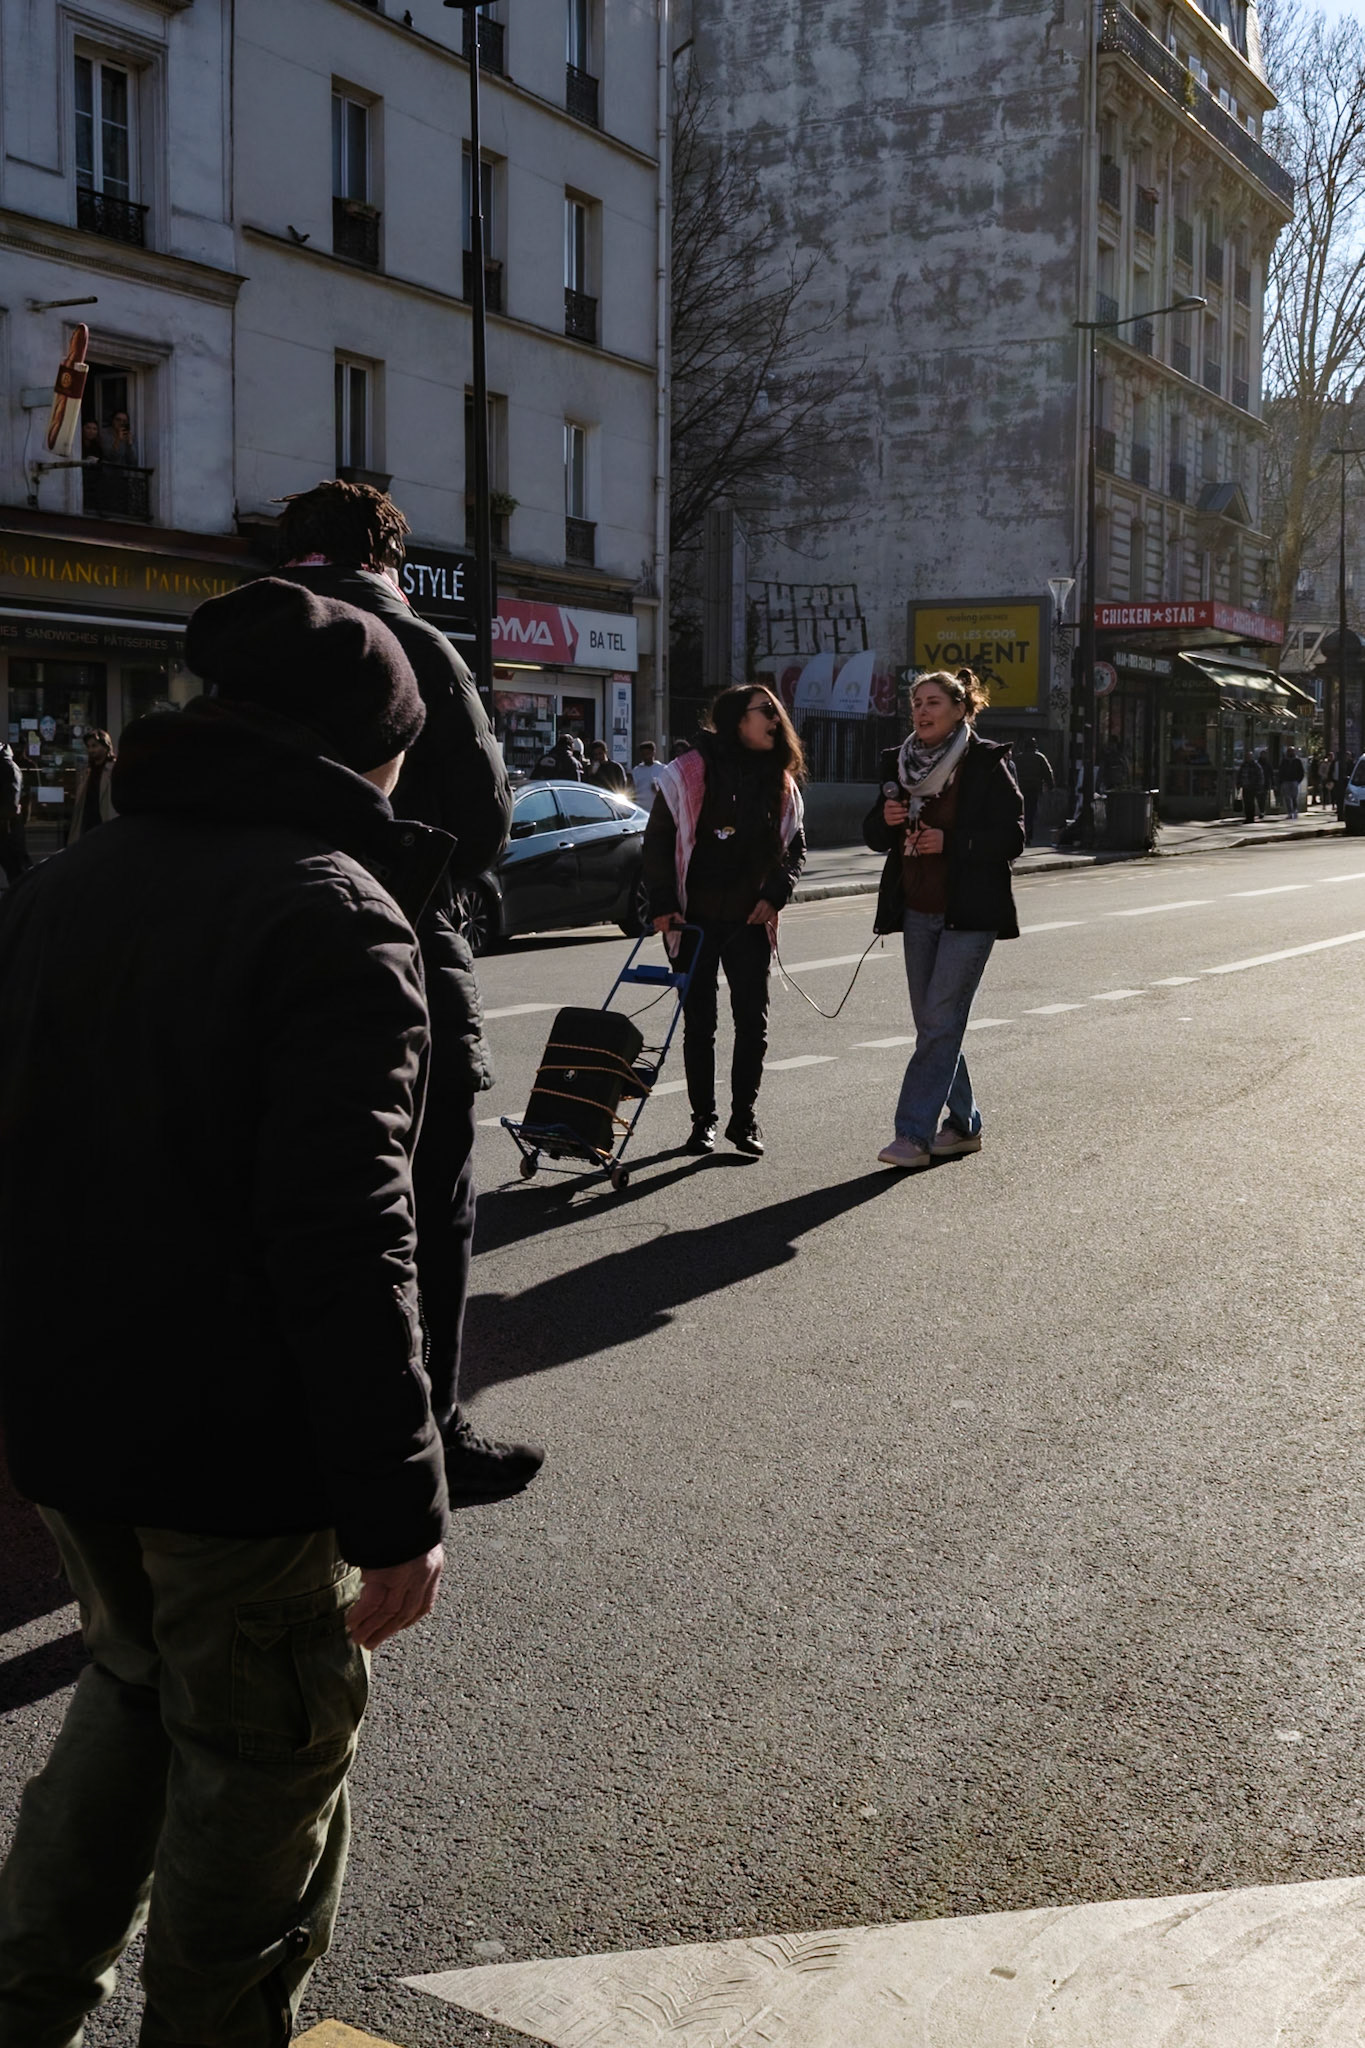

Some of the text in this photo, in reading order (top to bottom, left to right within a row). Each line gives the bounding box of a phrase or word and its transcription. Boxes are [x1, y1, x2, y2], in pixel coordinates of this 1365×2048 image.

[403, 562, 465, 602] STYLÉ
[1102, 607, 1195, 625] CHICKEN STAR
[24, 628, 98, 645] SANDWICHES
[590, 630, 627, 651] BA TEL
[963, 631, 981, 640] LES
[924, 641, 1030, 665] VOLENT
